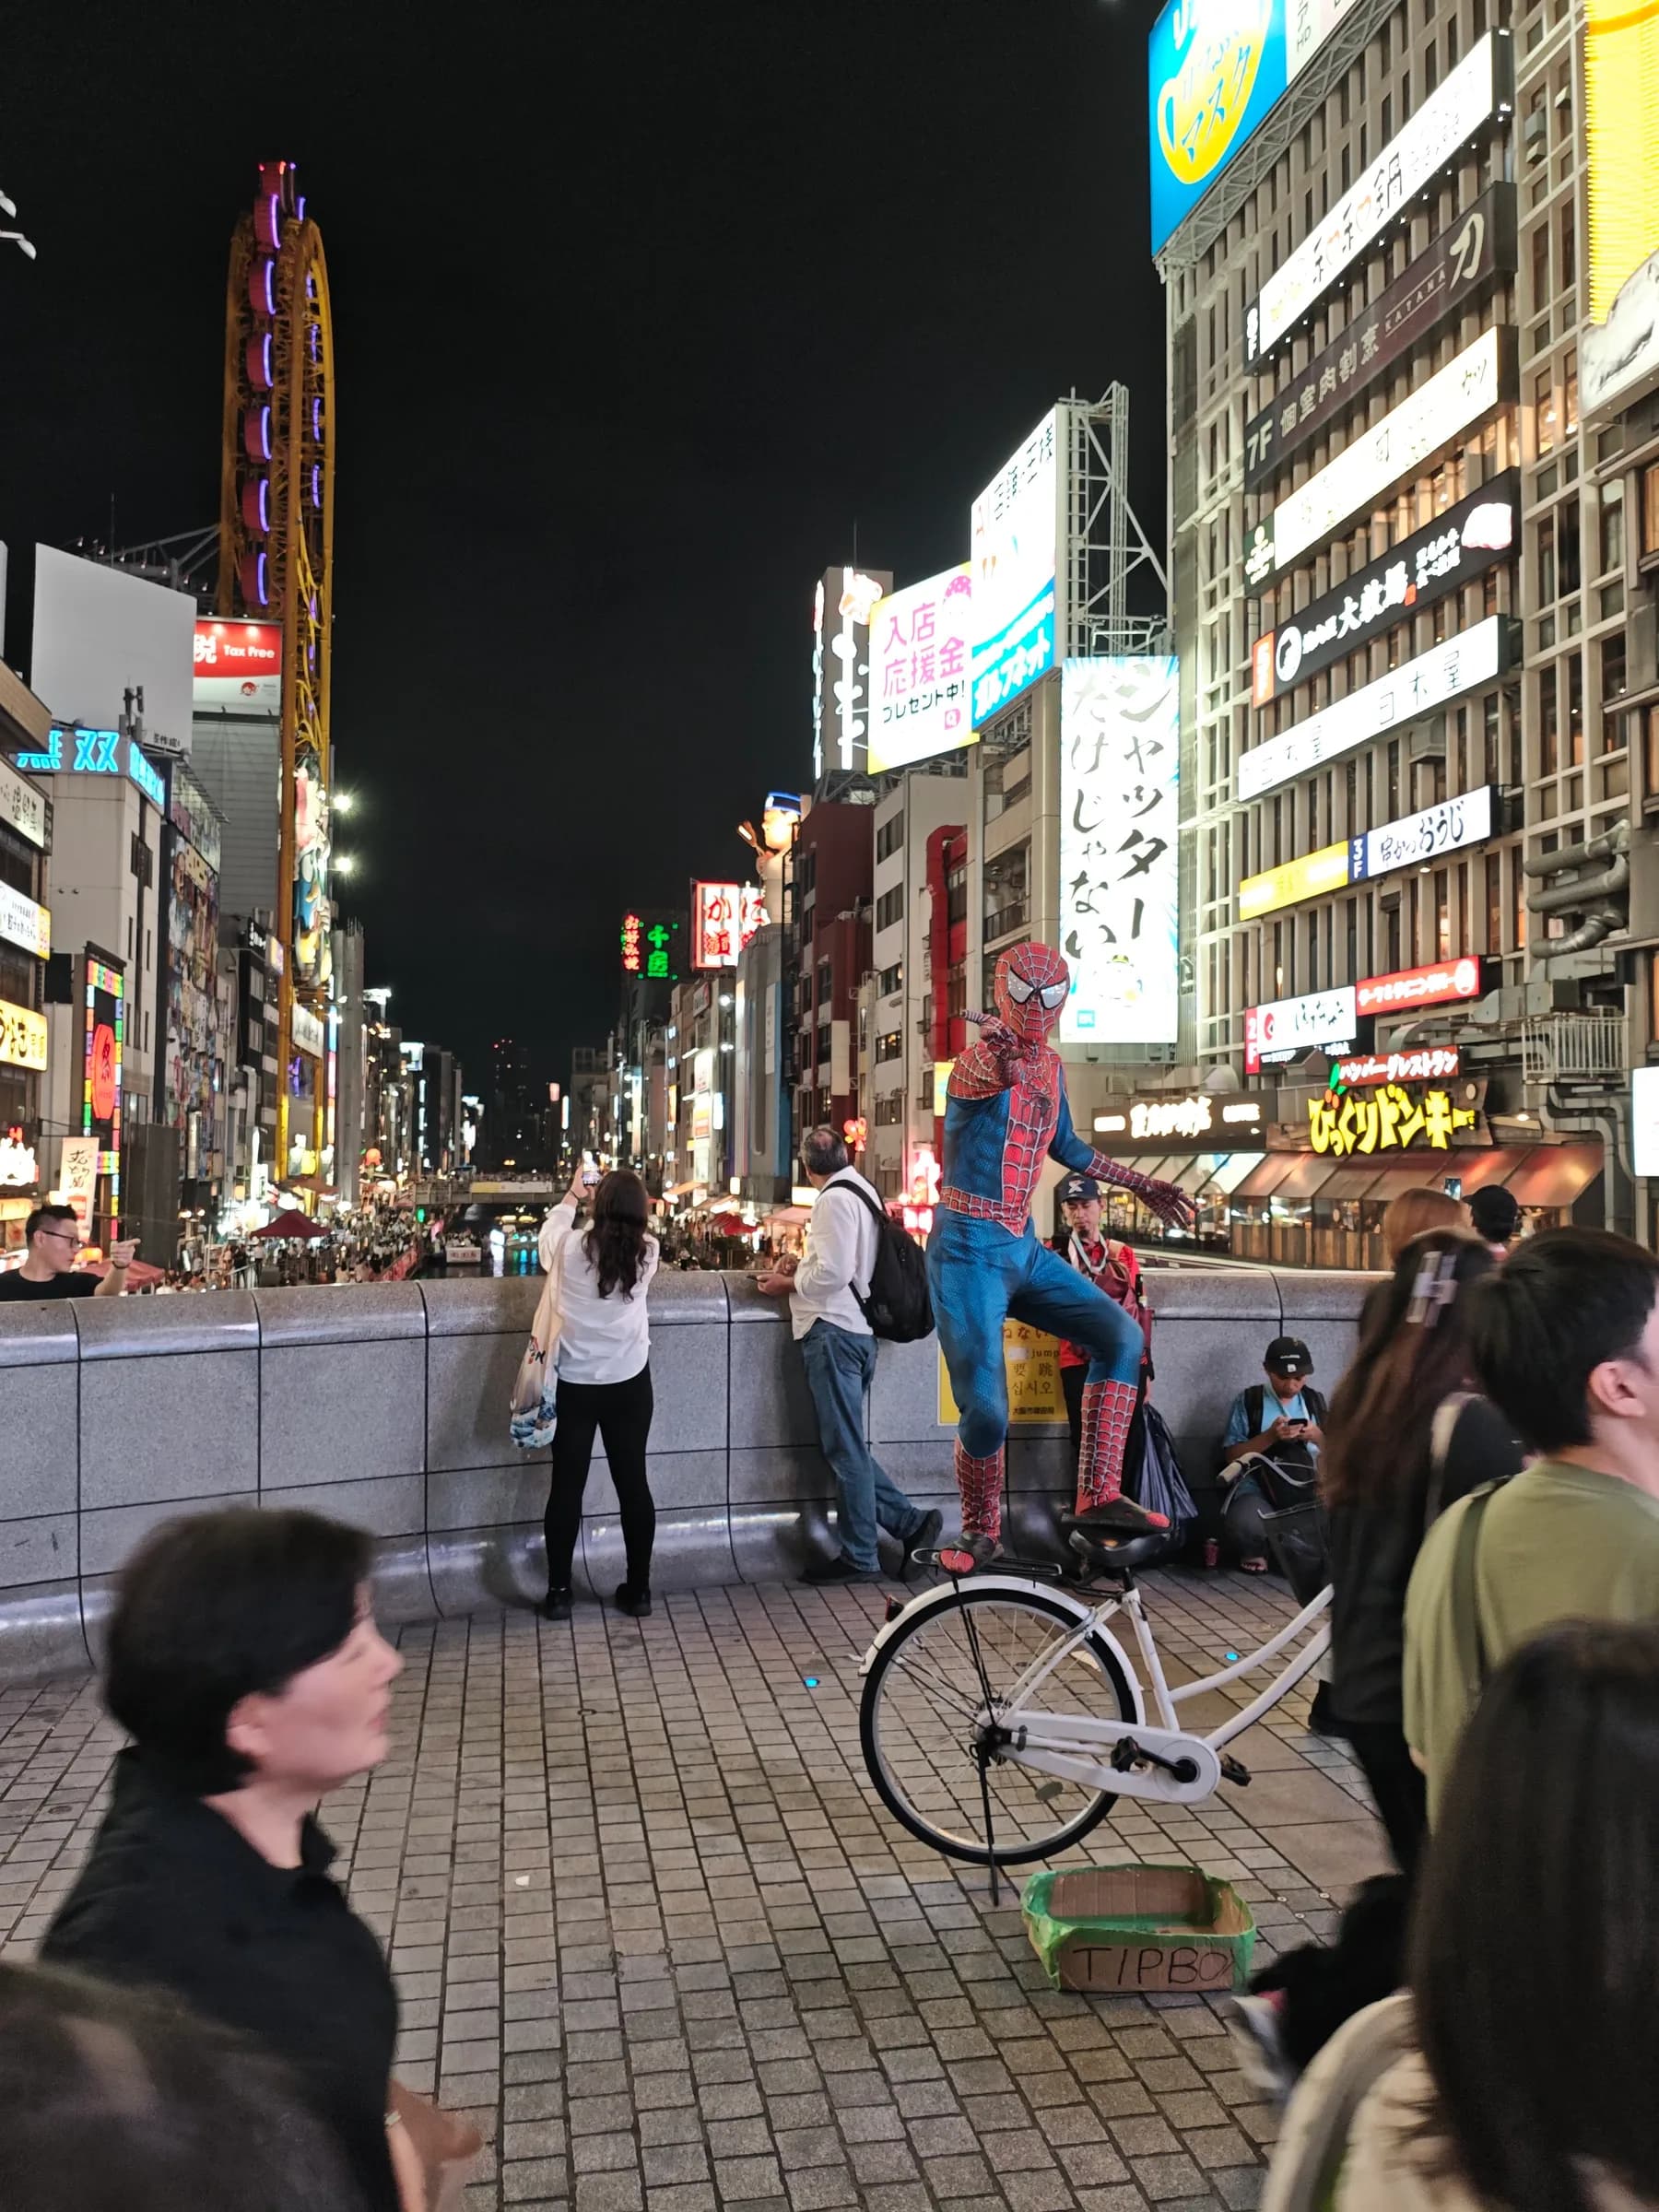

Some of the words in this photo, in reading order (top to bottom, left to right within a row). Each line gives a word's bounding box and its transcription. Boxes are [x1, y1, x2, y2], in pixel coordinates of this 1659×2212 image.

[1247, 419, 1274, 472] 7F
[1385, 269, 1446, 333] KATANA
[1449, 213, 1485, 292] 刀
[223, 644, 245, 657] Tax
[884, 601, 936, 654] 入店
[883, 636, 965, 699] 応援金
[1352, 838, 1364, 879] 3F
[705, 894, 766, 924] かに
[1247, 1017, 1258, 1065] 2F
[1308, 1083, 1476, 1157] びっくりドンキー
